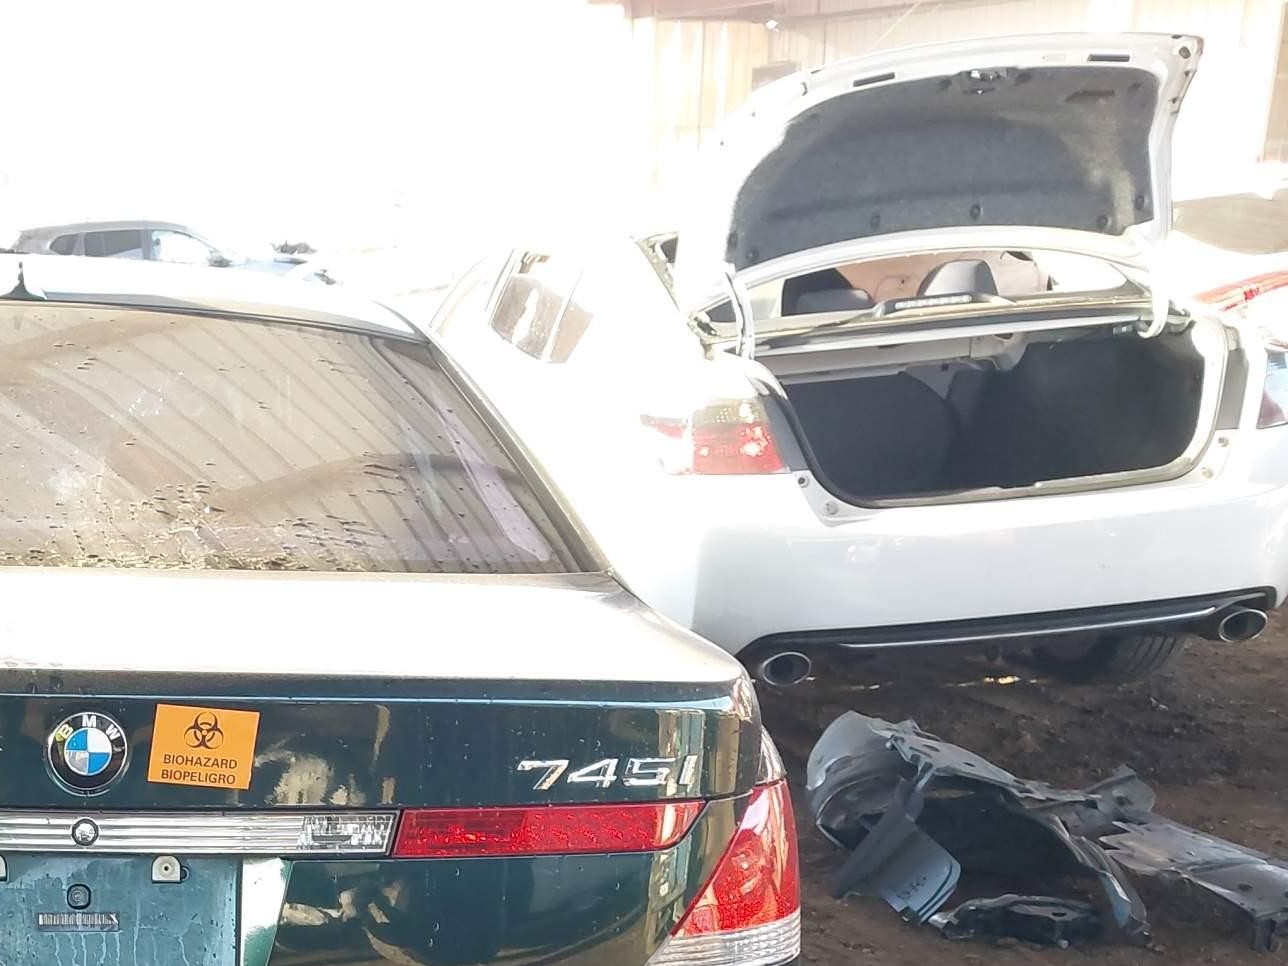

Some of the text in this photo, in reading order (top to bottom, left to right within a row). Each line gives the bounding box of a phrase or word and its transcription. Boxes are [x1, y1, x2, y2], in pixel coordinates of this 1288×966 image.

[54, 714, 120, 742] BMW
[163, 753, 238, 769] BIOHAZARD
[161, 769, 236, 785] BIOPELIGRO
